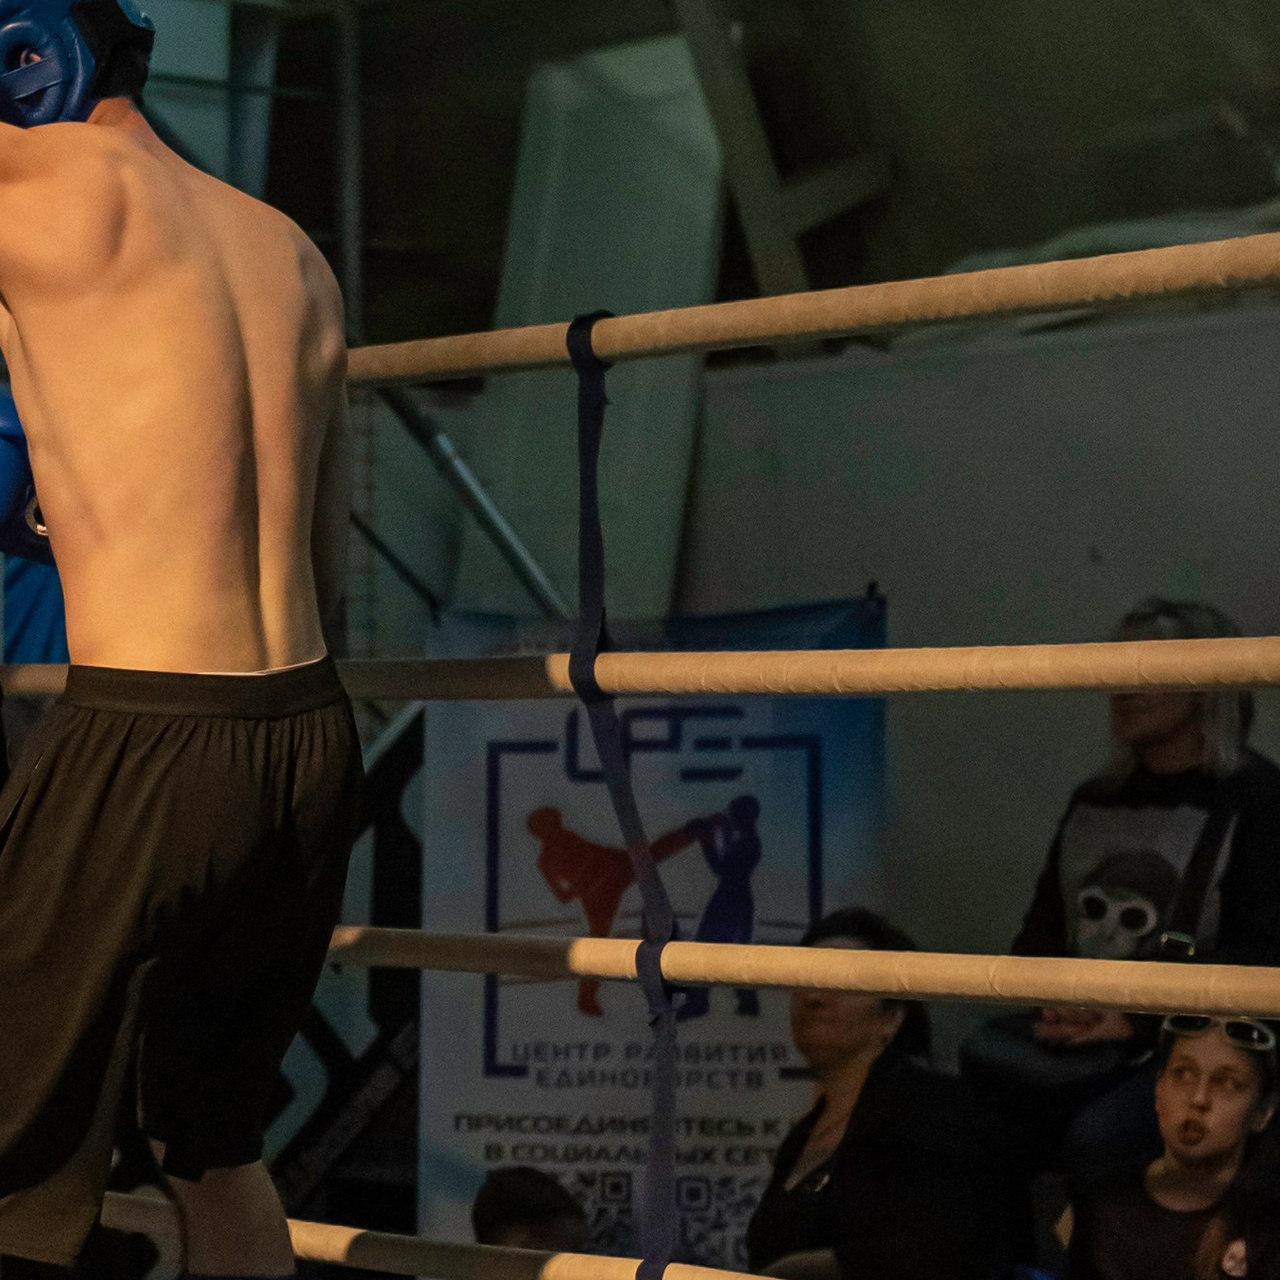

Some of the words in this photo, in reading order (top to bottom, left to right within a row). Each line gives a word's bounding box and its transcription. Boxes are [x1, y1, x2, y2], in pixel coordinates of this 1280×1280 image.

[511, 1041, 612, 1064] ЦЕНТР
[535, 1067, 764, 1091] ЕДИНОРСТВ
[453, 1113, 755, 1136] ПРИСОЕДИНТЕСЬ
[484, 1141, 504, 1161] В
[510, 1141, 718, 1166] СОЦИАЛЬЫХ
